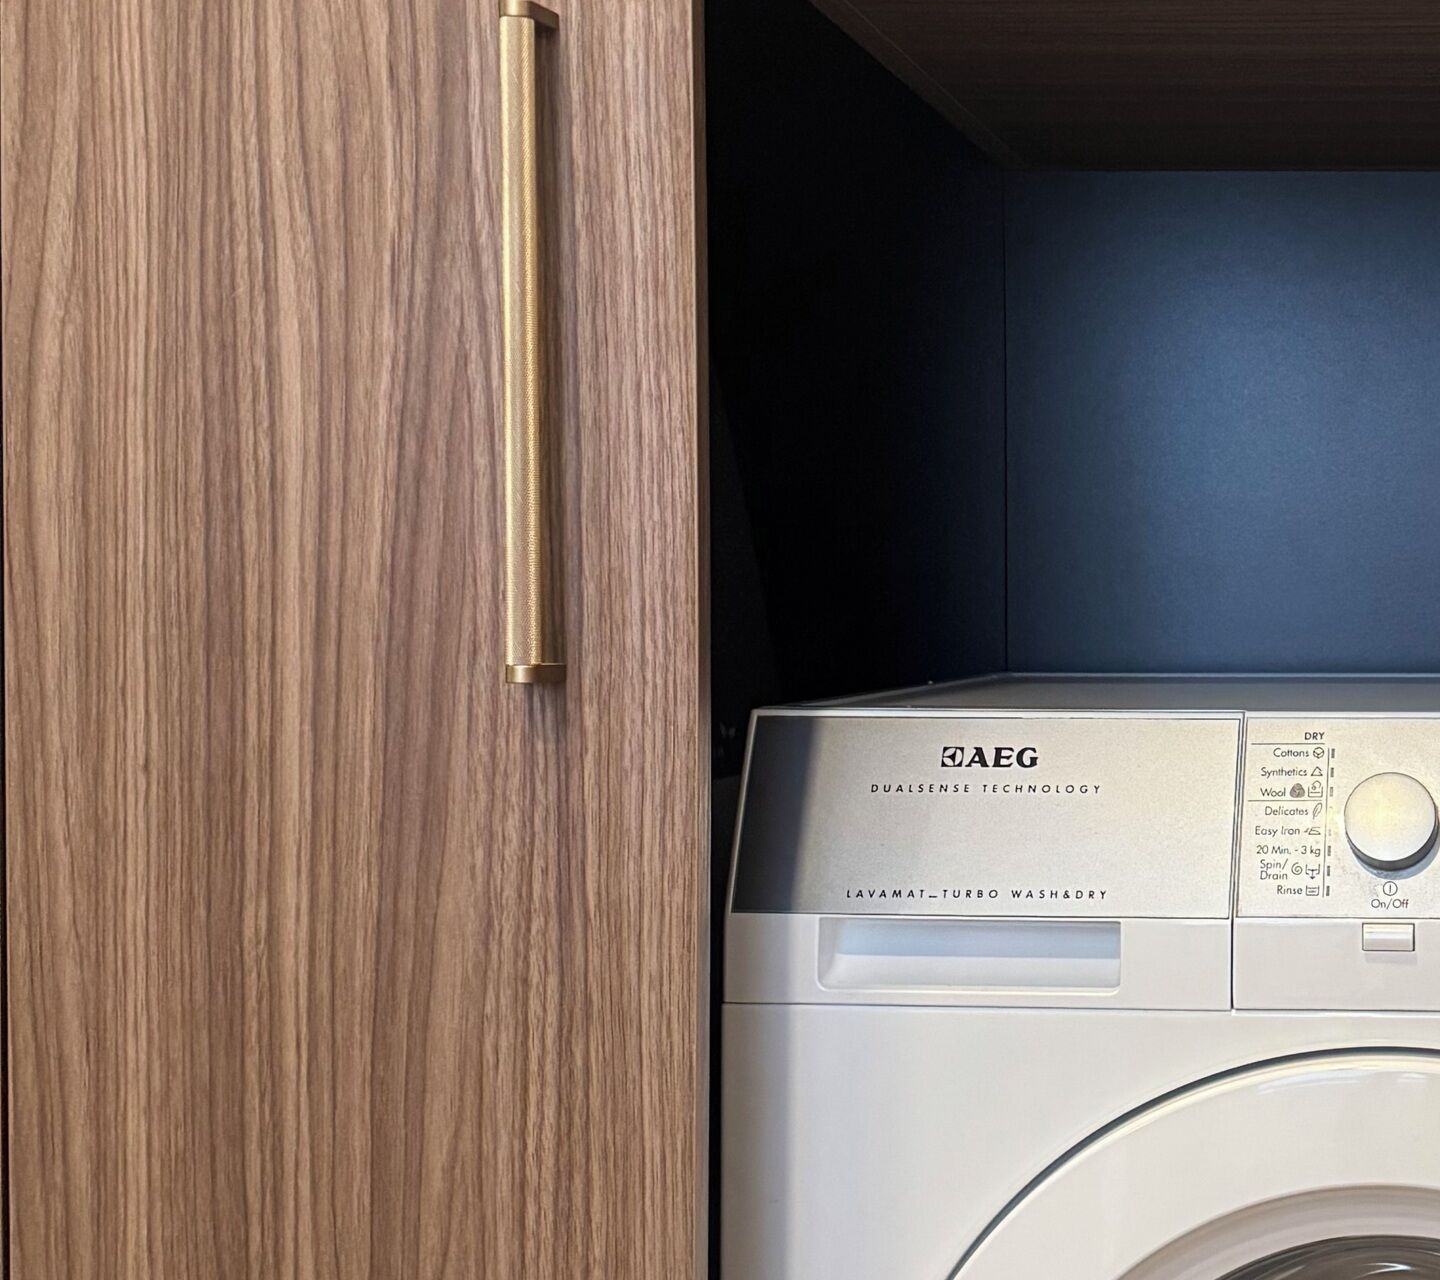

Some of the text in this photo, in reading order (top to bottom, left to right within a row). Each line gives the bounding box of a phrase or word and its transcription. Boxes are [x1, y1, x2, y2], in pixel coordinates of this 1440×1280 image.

[1304, 732, 1325, 740] DRY
[965, 746, 1039, 768] AEG
[1273, 747, 1310, 757] Cottons
[1260, 766, 1307, 779] Synthetics
[870, 784, 1100, 794] DUALSENSE TECHNOLOGY
[1260, 787, 1286, 797] Wool
[1264, 806, 1309, 816] Delicates
[1255, 826, 1300, 837] Easy Iron
[1256, 845, 1269, 854] 20
[1301, 846, 1307, 855] 3
[1310, 846, 1321, 857] kg
[1260, 858, 1288, 870] Spin/
[1260, 870, 1288, 880] Drain
[1276, 884, 1303, 895] Rinse
[1011, 890, 1107, 900] WASH&DRY
[1371, 898, 1409, 910] On/Off
